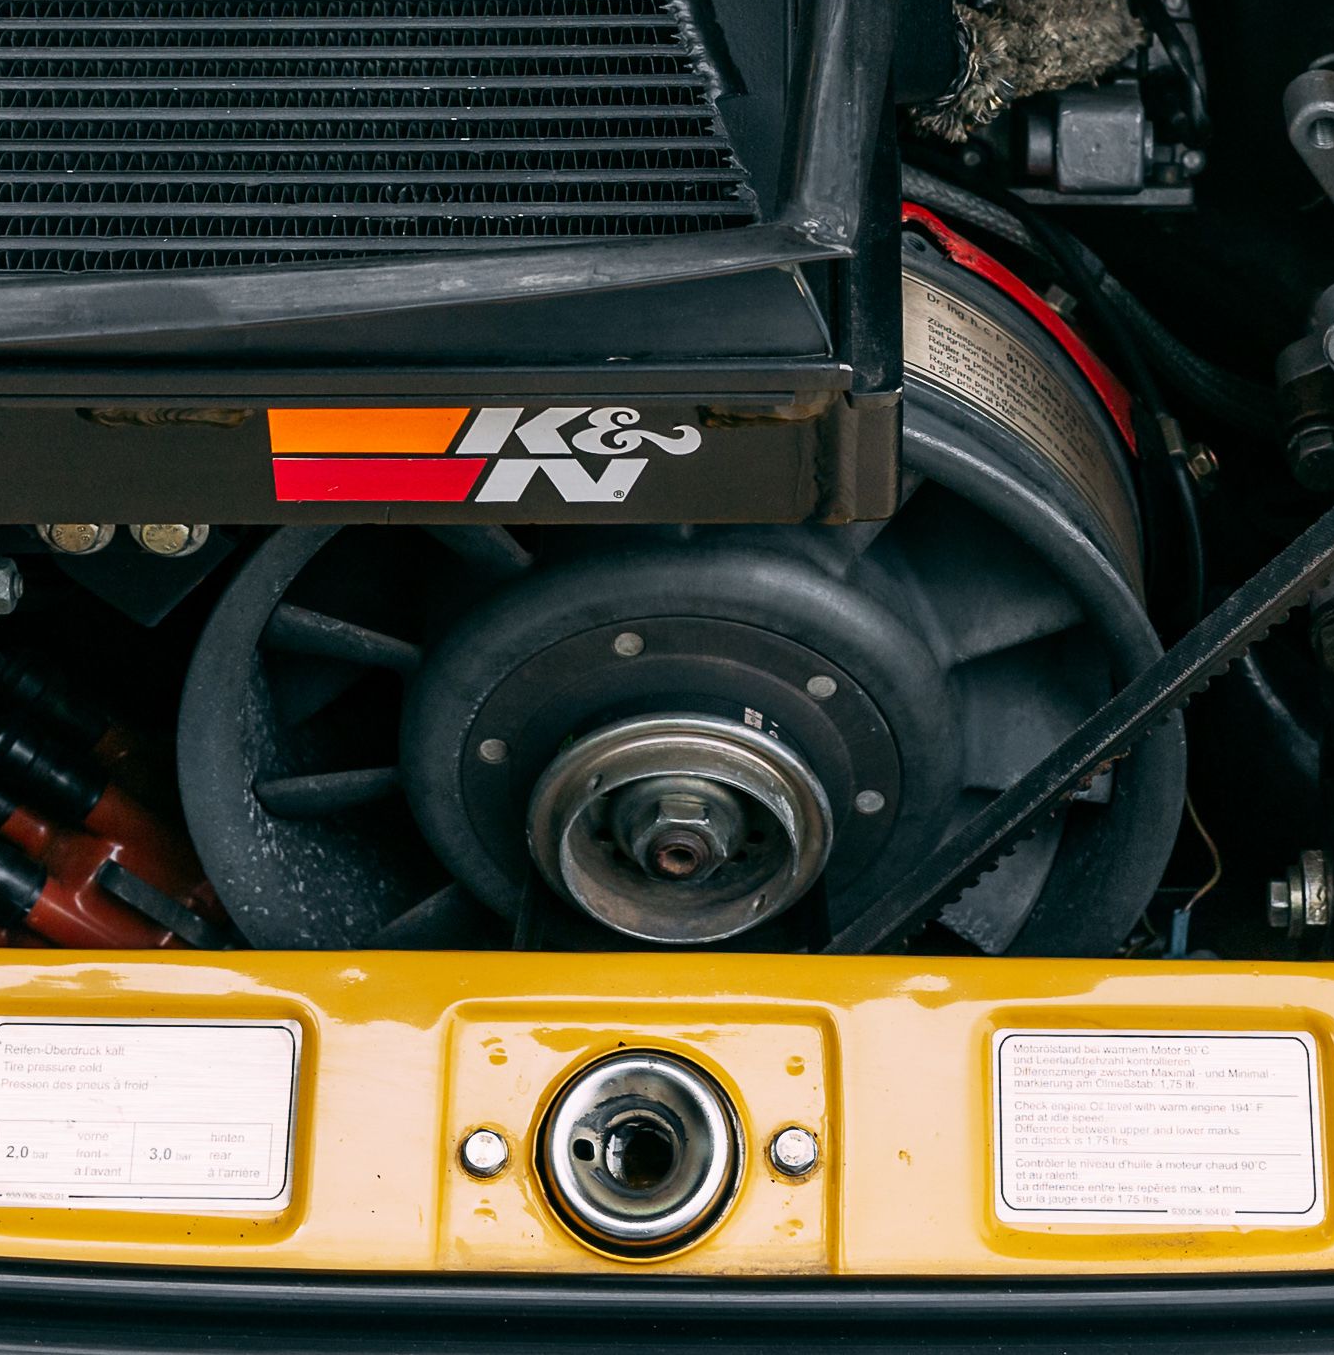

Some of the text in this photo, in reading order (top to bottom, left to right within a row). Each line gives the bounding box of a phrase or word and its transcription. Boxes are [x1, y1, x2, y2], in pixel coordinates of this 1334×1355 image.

[1007, 352, 1027, 374] 911
[3, 1060, 103, 1076] Tire pressure cold
[0, 1078, 49, 1090] Pression
[52, 1079, 74, 1091] des
[76, 1081, 110, 1092] pneus
[124, 1079, 149, 1091] froid
[77, 1131, 109, 1142] vorne
[5, 1145, 29, 1160] 2,0
[148, 1146, 172, 1162] 3,0
[209, 1149, 232, 1161] rear
